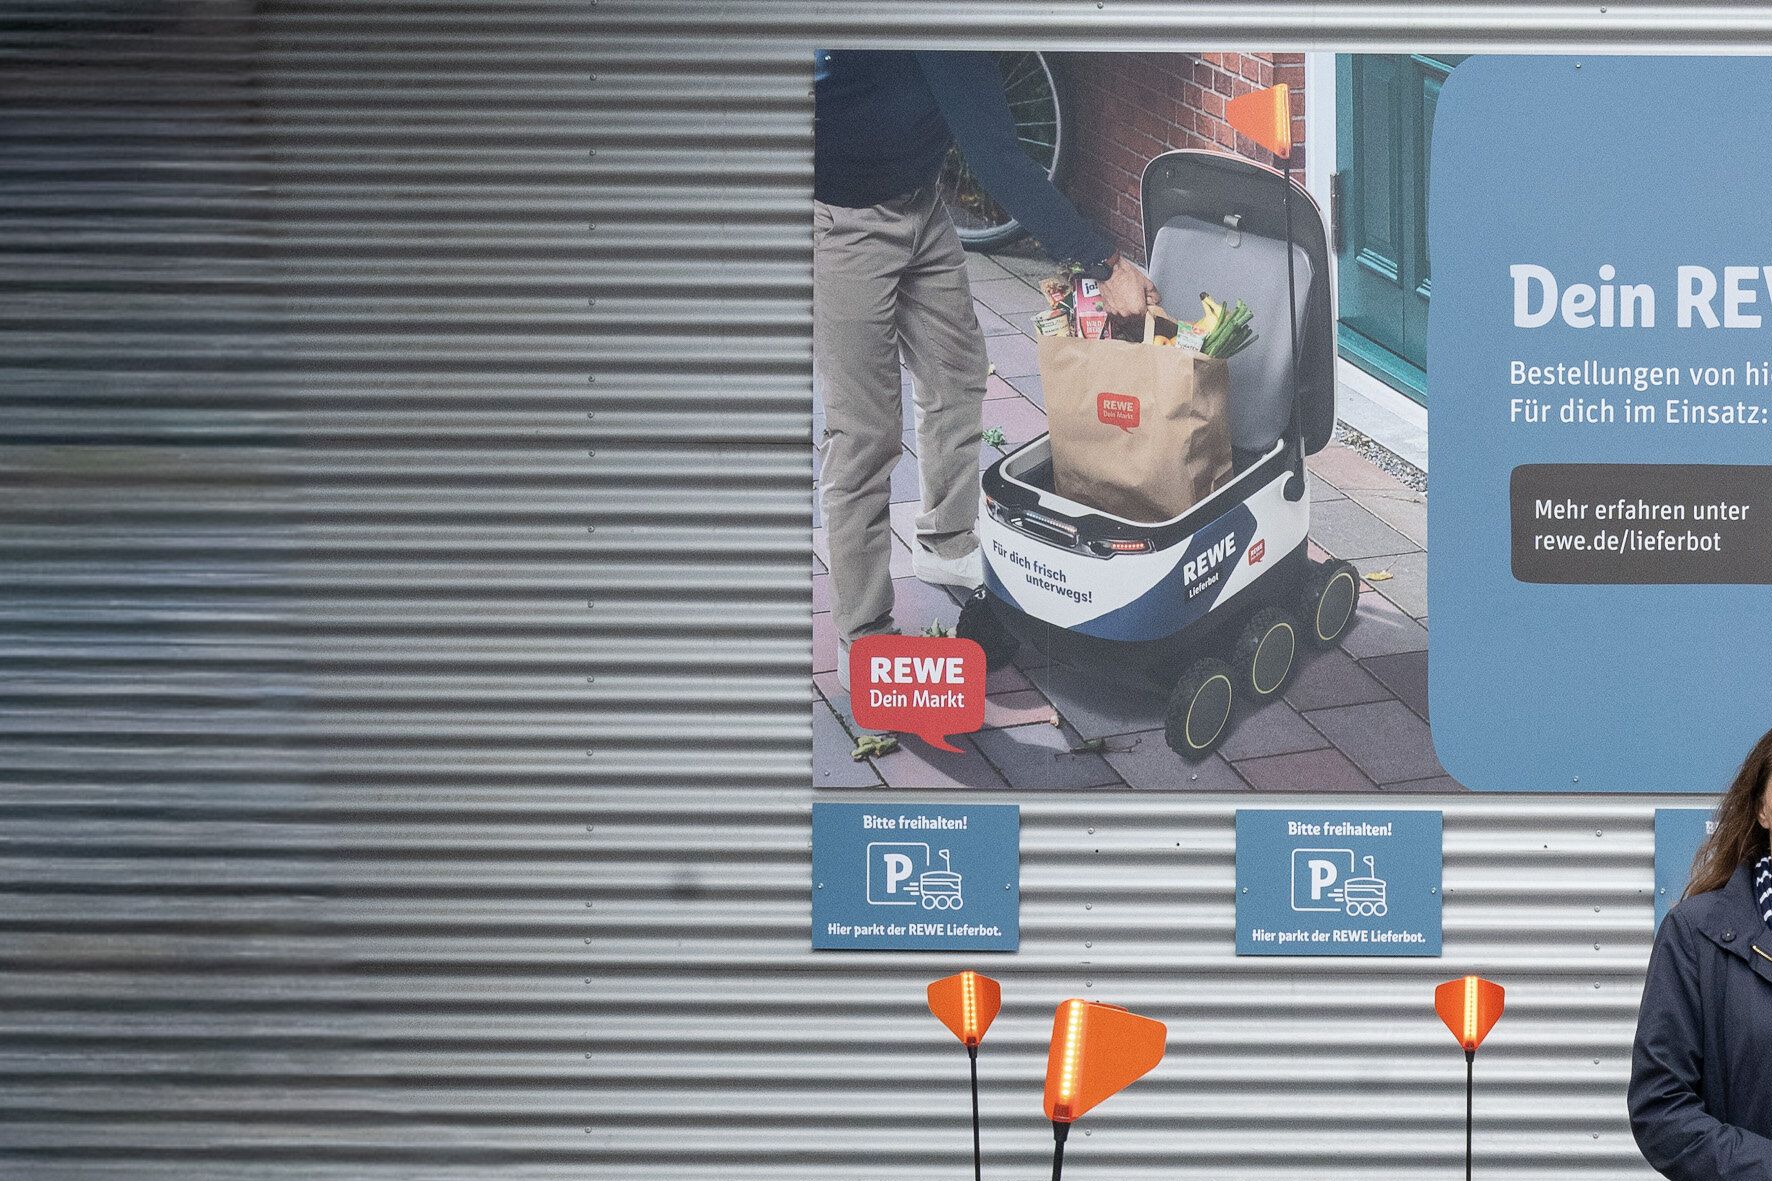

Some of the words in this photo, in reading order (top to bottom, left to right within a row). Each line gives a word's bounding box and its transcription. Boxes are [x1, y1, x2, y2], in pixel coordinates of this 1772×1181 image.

[1084, 281, 1099, 294] ja!
[1509, 263, 1655, 329] Dein
[1510, 359, 1680, 392] Bestellungen
[1689, 367, 1735, 386] von
[1103, 400, 1134, 412] REWE
[1103, 411, 1116, 419] Dein
[1510, 398, 1551, 423] Für
[1559, 398, 1614, 423] dich
[1624, 398, 1655, 423] im
[1666, 398, 1768, 424] Einsatz:
[1535, 498, 1589, 520] Mehr
[1595, 498, 1685, 520] erfahren
[1693, 501, 1750, 521] unter
[1535, 528, 1721, 554] rewe.de/lieferbot
[993, 540, 1008, 558] Für
[1010, 551, 1031, 570] dich
[1033, 561, 1067, 583] frisch
[1183, 532, 1237, 586] REWE
[1025, 573, 1093, 604] unterwegs!
[1189, 573, 1219, 598] Lieferbot
[870, 656, 965, 684] REWE
[869, 689, 908, 708] Dein
[912, 689, 965, 708] Markt
[862, 814, 896, 830] Bitte
[898, 815, 968, 830] freihalten!
[1287, 821, 1321, 836] Bitte
[1323, 821, 1393, 837] freihalten!
[883, 853, 913, 894] P
[1308, 859, 1338, 900] P
[828, 923, 852, 936] Hier
[854, 923, 885, 938] parkt
[887, 923, 906, 936] der
[908, 923, 945, 936] REWE
[946, 923, 1002, 937] Lieferbot.
[1252, 929, 1276, 942] Hier
[1278, 929, 1310, 945] parkt
[1311, 929, 1331, 943] der
[1332, 929, 1369, 943] REWE
[1370, 929, 1426, 944] Lieferbot.
